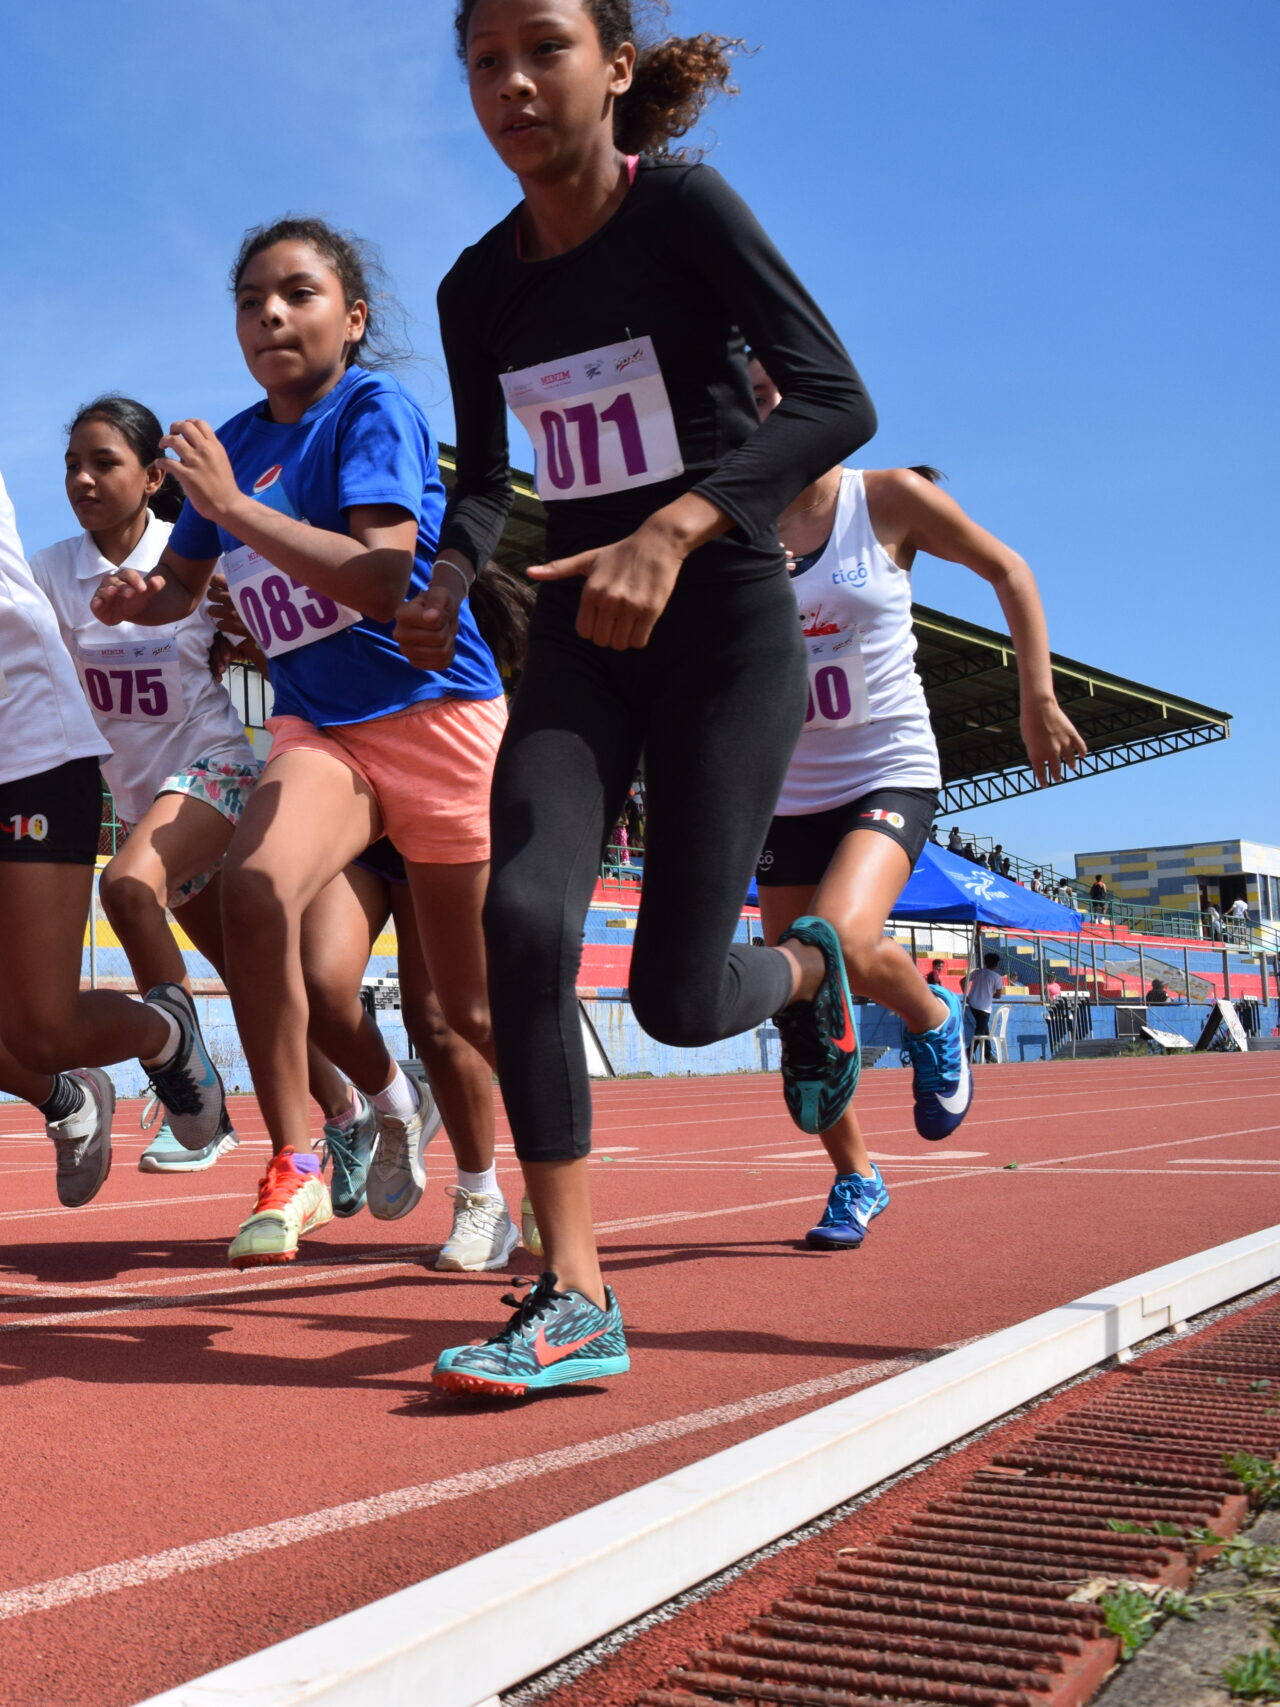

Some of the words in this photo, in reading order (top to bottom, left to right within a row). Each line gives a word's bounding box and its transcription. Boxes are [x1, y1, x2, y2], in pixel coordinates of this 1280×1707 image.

[540, 392, 648, 490] 071
[239, 575, 340, 651] 083
[84, 667, 169, 717] 075
[805, 666, 851, 722] 0
[9, 813, 49, 841] 10
[870, 808, 905, 829] 10
